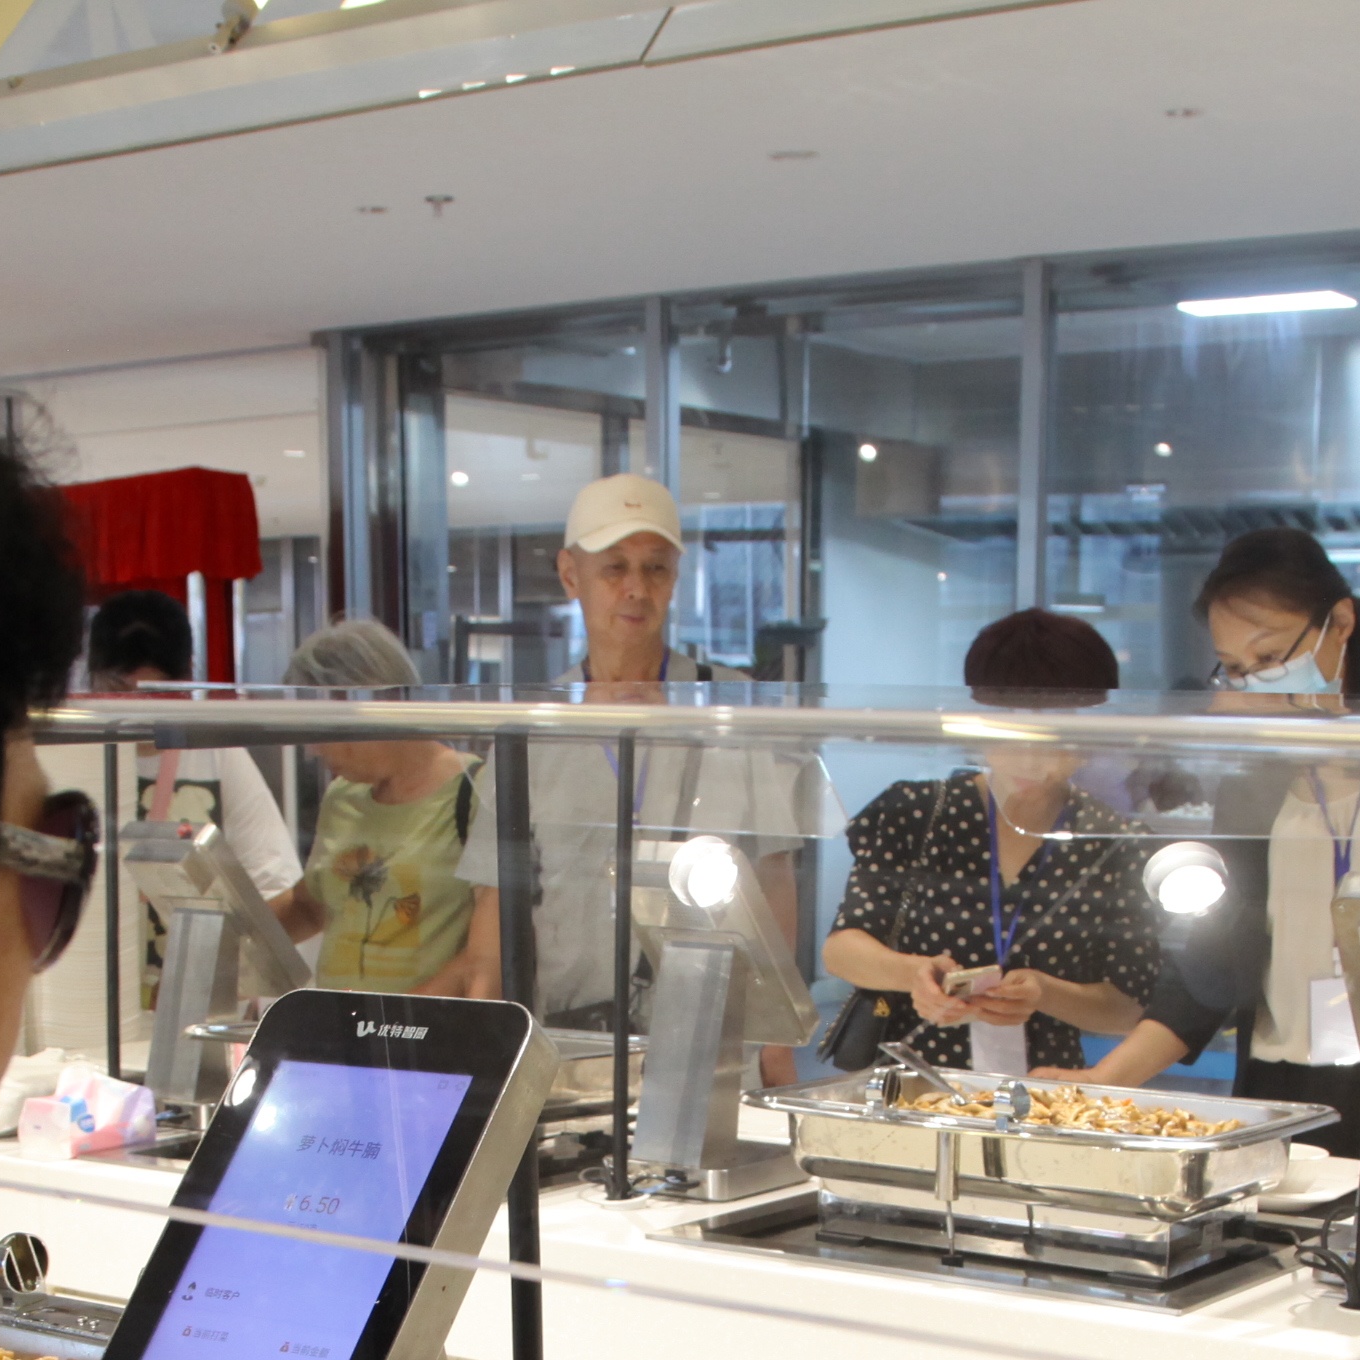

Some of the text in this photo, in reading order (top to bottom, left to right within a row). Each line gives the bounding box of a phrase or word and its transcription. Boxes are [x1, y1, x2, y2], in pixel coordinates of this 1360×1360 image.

[296, 1134, 383, 1160] 萝卜焖牛腩
